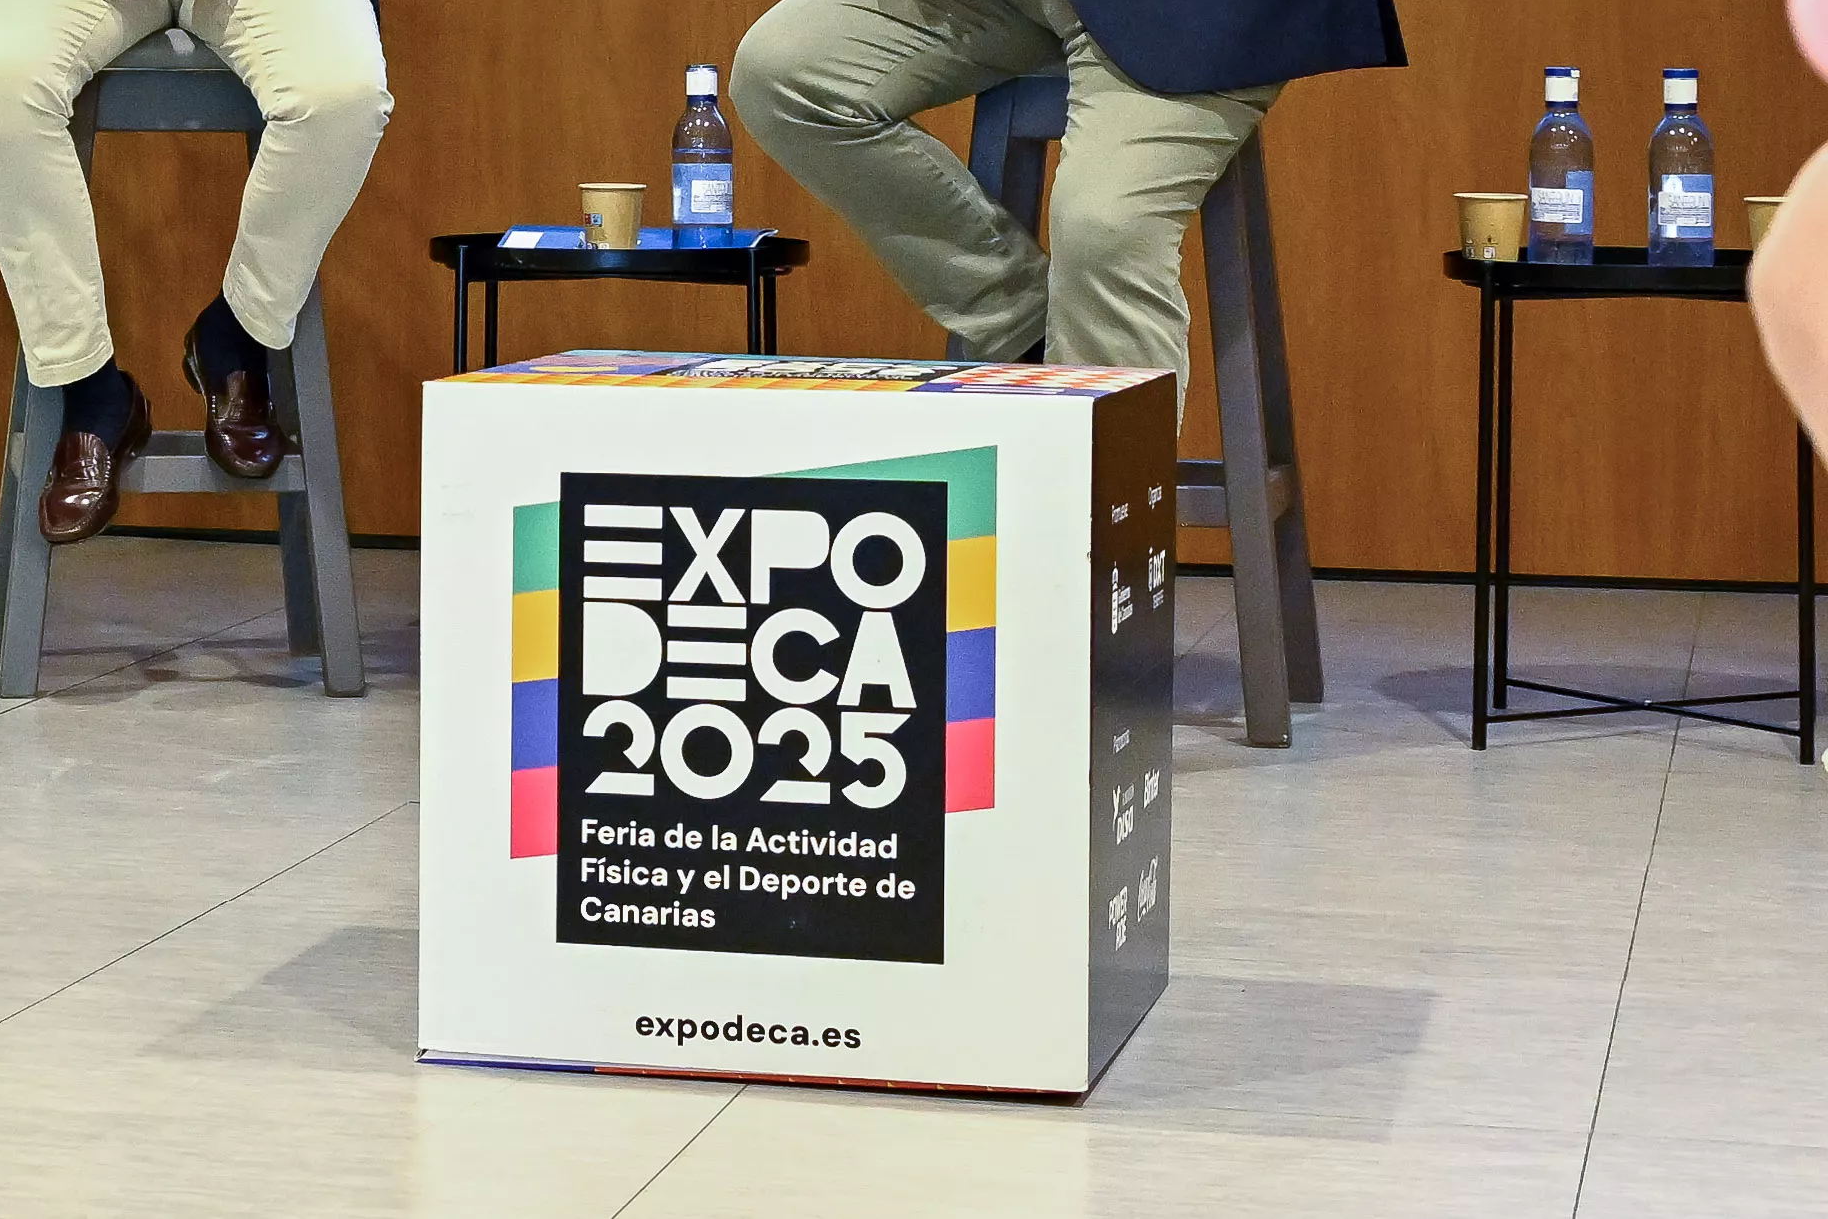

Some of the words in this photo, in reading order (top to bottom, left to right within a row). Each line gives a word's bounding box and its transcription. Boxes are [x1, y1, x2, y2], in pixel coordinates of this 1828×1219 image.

[583, 504, 926, 608] EXPO
[583, 602, 917, 708] DECA
[583, 700, 911, 808] 2025
[582, 819, 655, 847] Feria
[664, 823, 702, 849] de
[712, 825, 737, 850] la
[746, 827, 897, 859] Actividad
[581, 857, 667, 886] Física
[677, 870, 695, 894] y
[704, 865, 729, 889] el
[740, 866, 866, 900] Deporte
[876, 873, 915, 899] de
[581, 897, 715, 928] Canarias
[636, 1015, 860, 1048] expodeca.es
